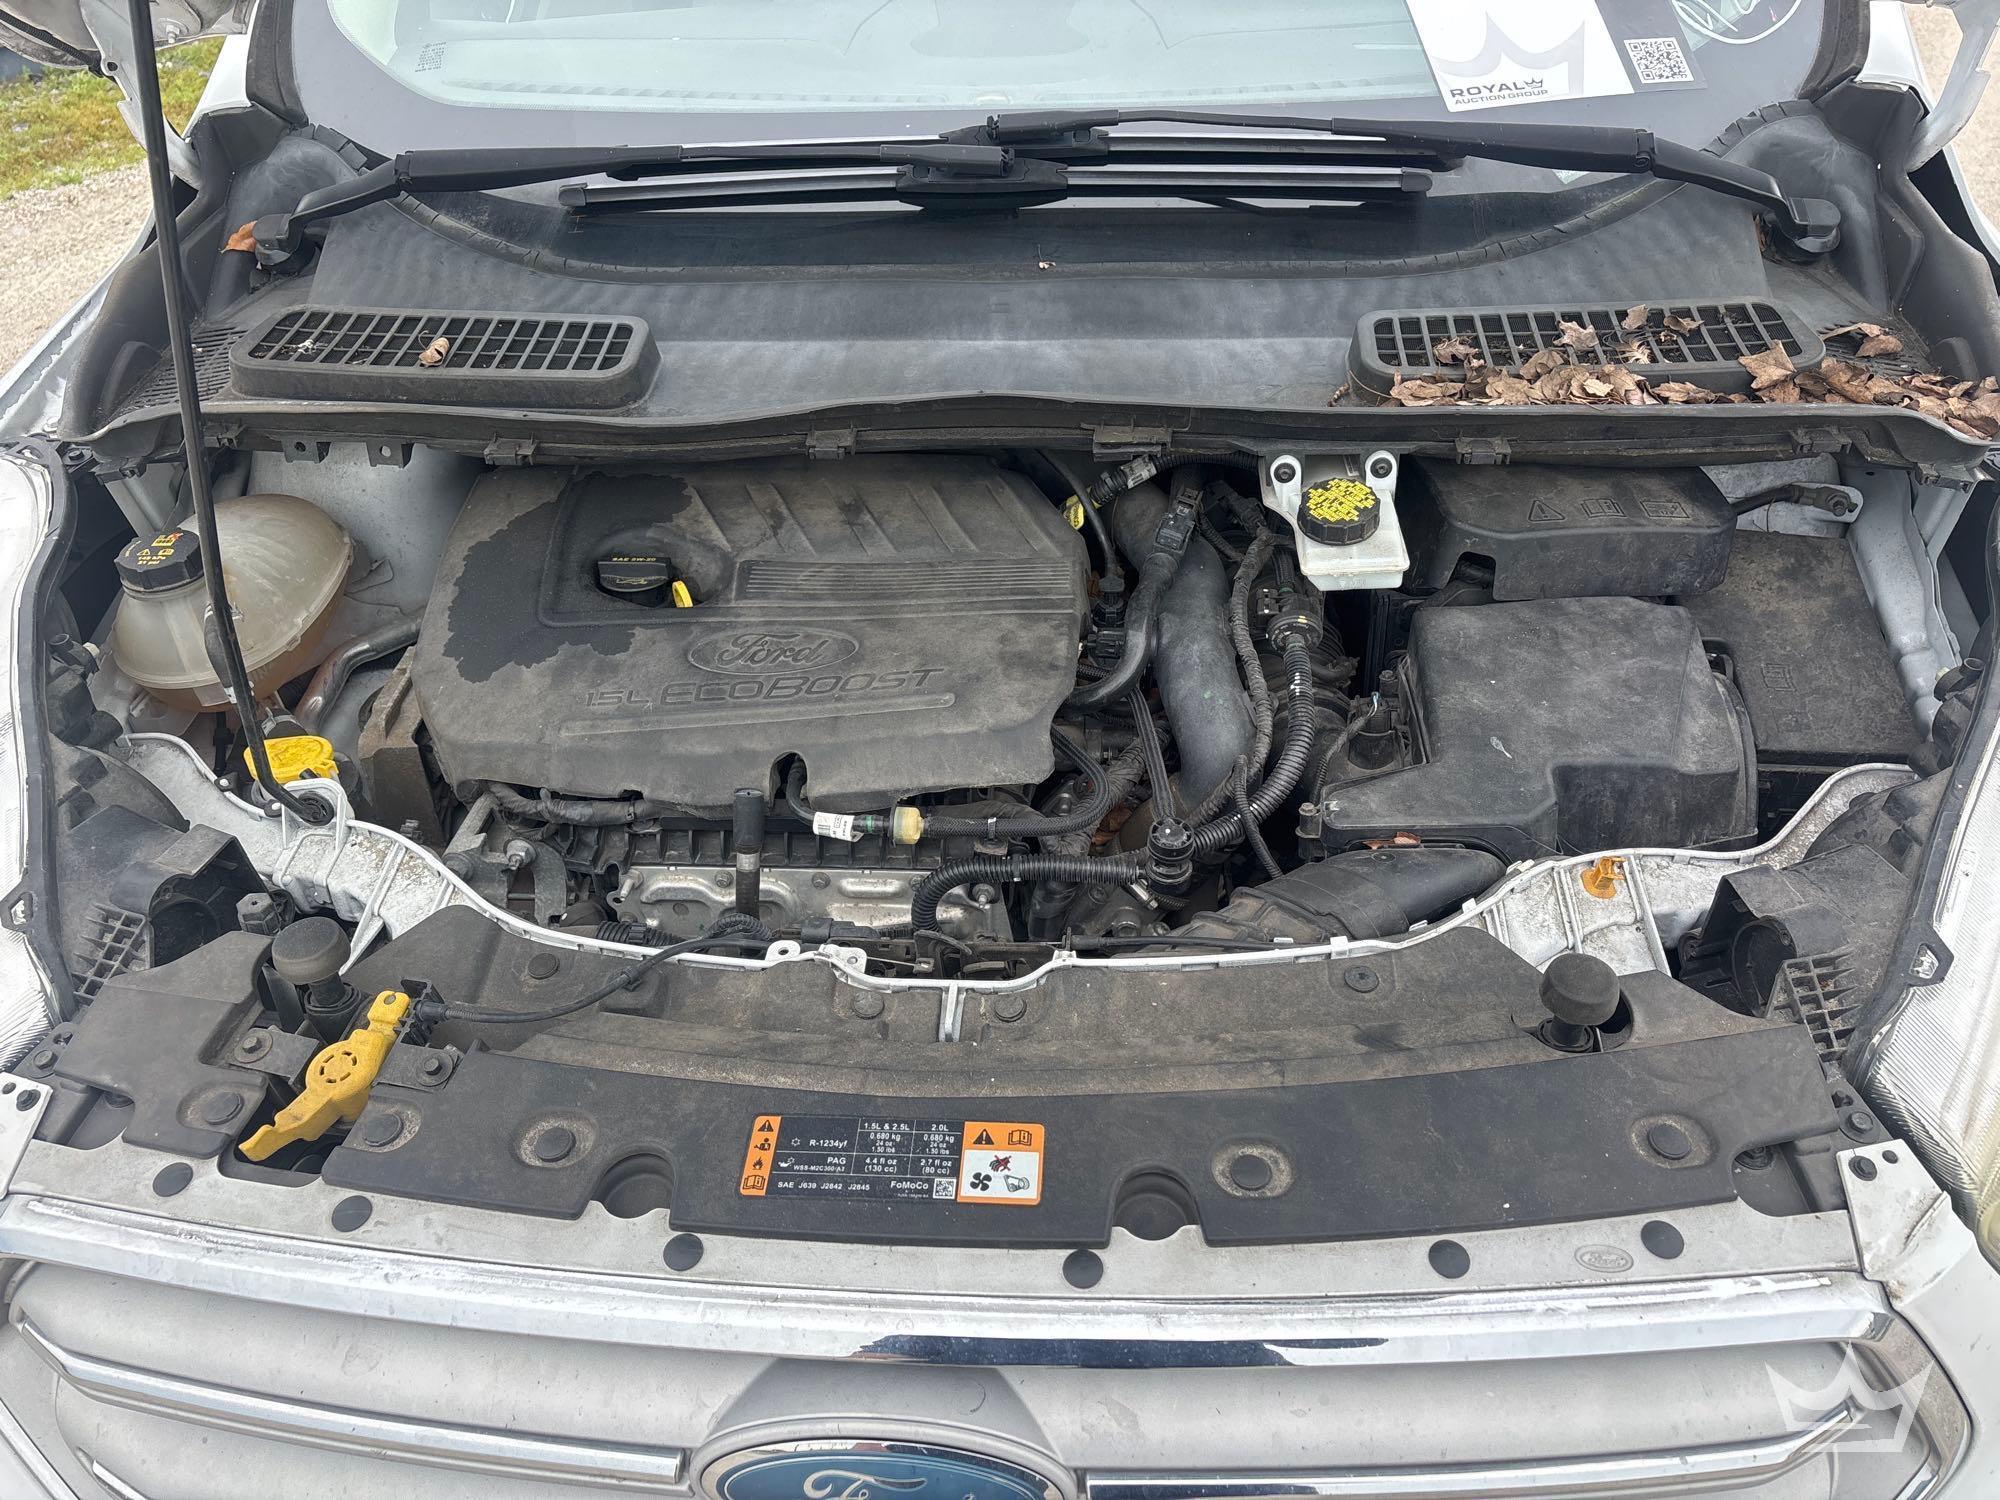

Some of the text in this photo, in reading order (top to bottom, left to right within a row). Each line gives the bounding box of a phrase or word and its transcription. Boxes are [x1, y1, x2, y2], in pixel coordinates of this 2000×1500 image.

[1450, 82, 1525, 98] ROYAL
[1455, 89, 1548, 105] AUCTION GROUP
[718, 633, 829, 666] Ford
[585, 668, 944, 708] 1.5L ECOBOOST
[864, 1122, 881, 1130] 1.5L
[892, 1123, 910, 1131] 2.5L
[931, 1124, 949, 1132] 2.0L
[869, 1132, 901, 1142] 0.680 kg
[923, 1133, 955, 1144] 0.680 kg
[809, 1139, 848, 1149] R-1234yf
[826, 1157, 847, 1165] PAG
[865, 1157, 879, 1165] 4.4
[879, 1157, 886, 1165] fl
[864, 1165, 897, 1173] (130 cc)
[922, 1166, 950, 1175] (80 cc)
[890, 1180, 929, 1190] FoMoCo
